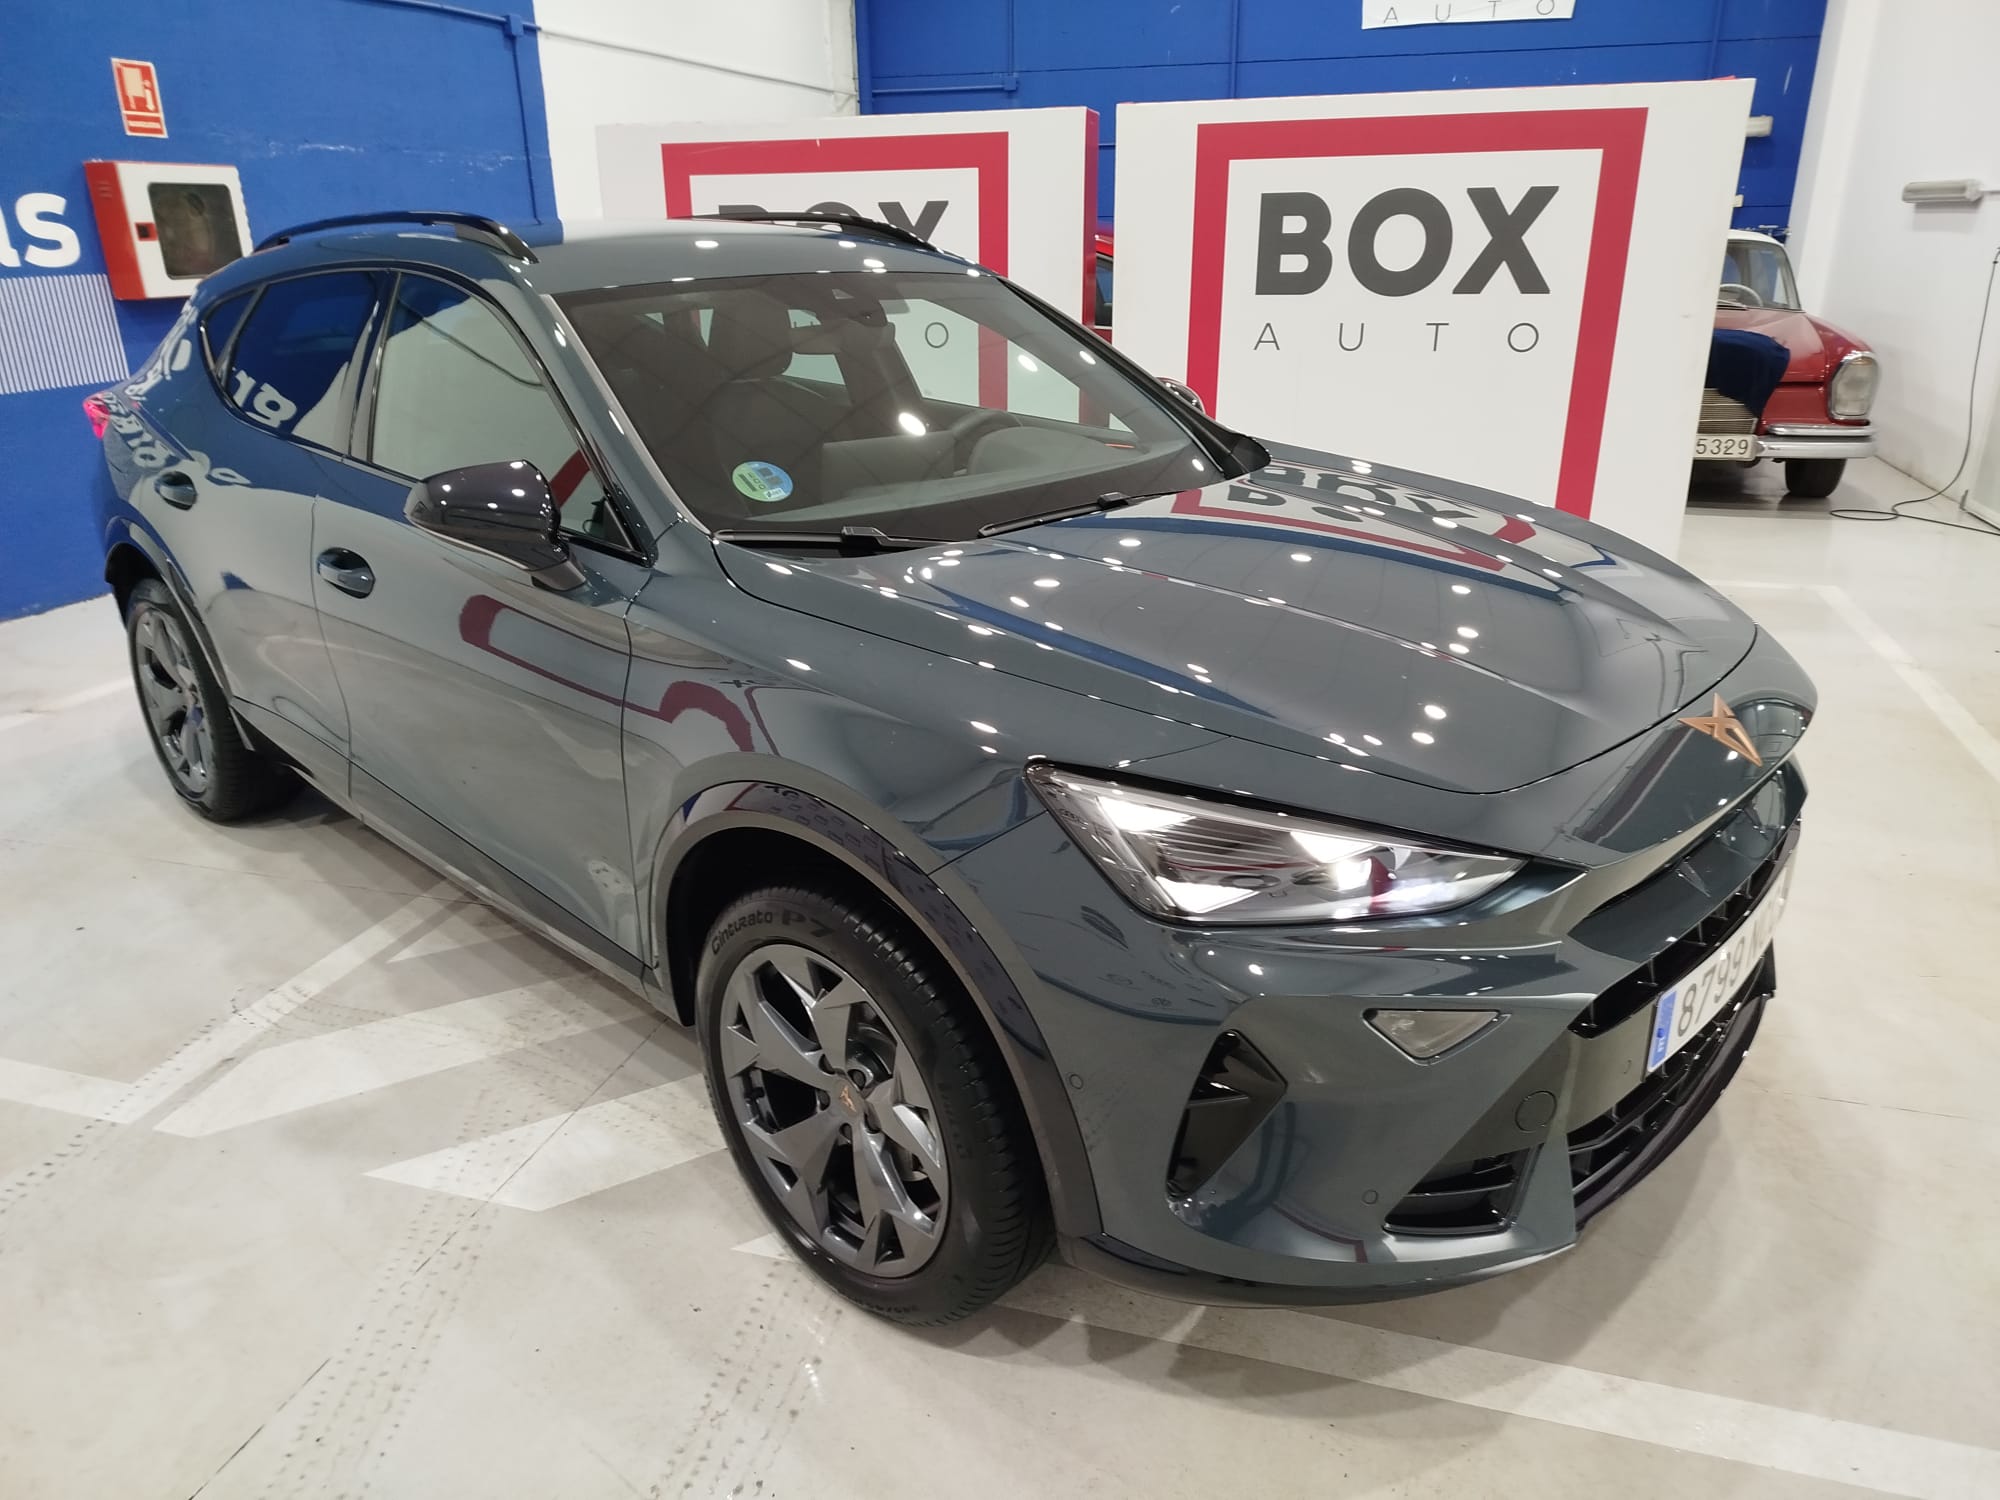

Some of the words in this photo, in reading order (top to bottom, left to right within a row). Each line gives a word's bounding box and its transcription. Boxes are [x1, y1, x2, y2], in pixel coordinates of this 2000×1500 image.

[1383, 0, 1555, 24] AUTO
[1255, 185, 1560, 297] BOX
[1253, 321, 1540, 353] AUTO
[1695, 438, 1749, 455] 5329
